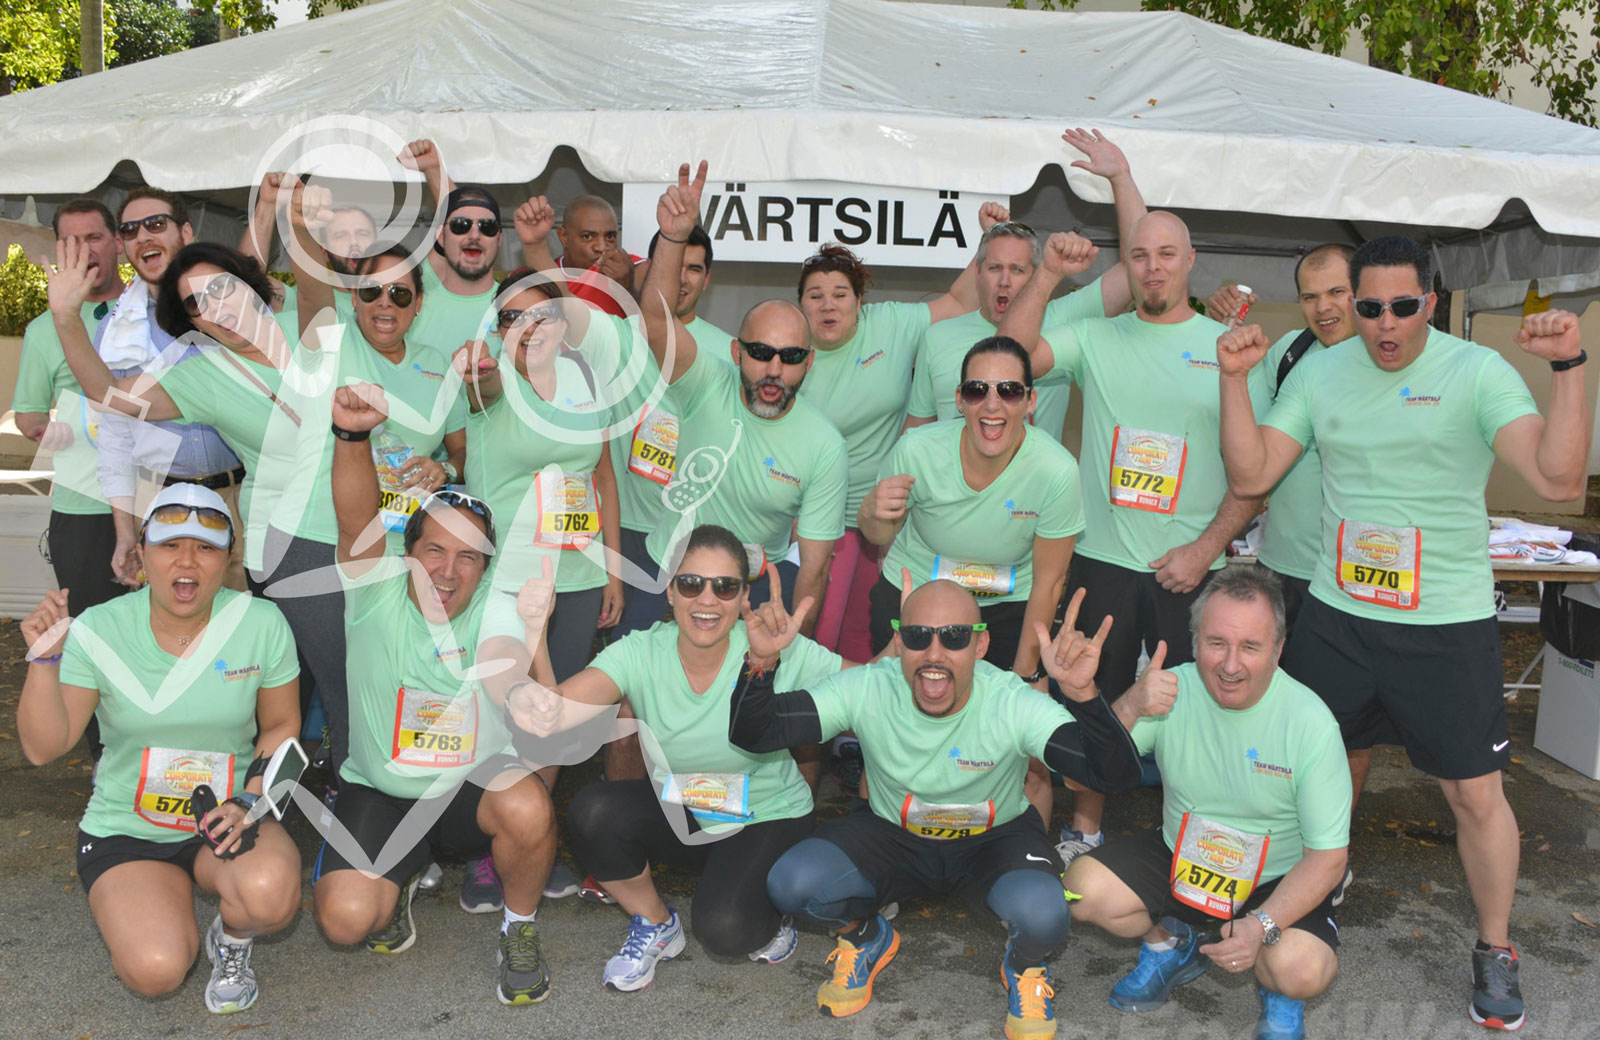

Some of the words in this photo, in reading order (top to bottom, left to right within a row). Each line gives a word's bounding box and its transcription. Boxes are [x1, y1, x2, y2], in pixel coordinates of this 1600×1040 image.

[702, 182, 967, 249] ÄRTSILÄ
[640, 443, 676, 470] 5781
[1127, 446, 1168, 461] CORPORATE
[1120, 469, 1164, 494] 5772
[554, 513, 590, 532] 5762
[1355, 539, 1400, 556] CORPORATE
[952, 568, 996, 581] CORPORATE
[1354, 565, 1400, 589] 5770
[413, 731, 462, 752] 5763
[164, 769, 213, 783] CORPORATE
[681, 787, 729, 800] CORPORATE
[155, 796, 195, 816] 576
[1197, 838, 1245, 863] CORPORATE
[1188, 864, 1239, 899] 5774
[1208, 899, 1231, 913] RUNNER
